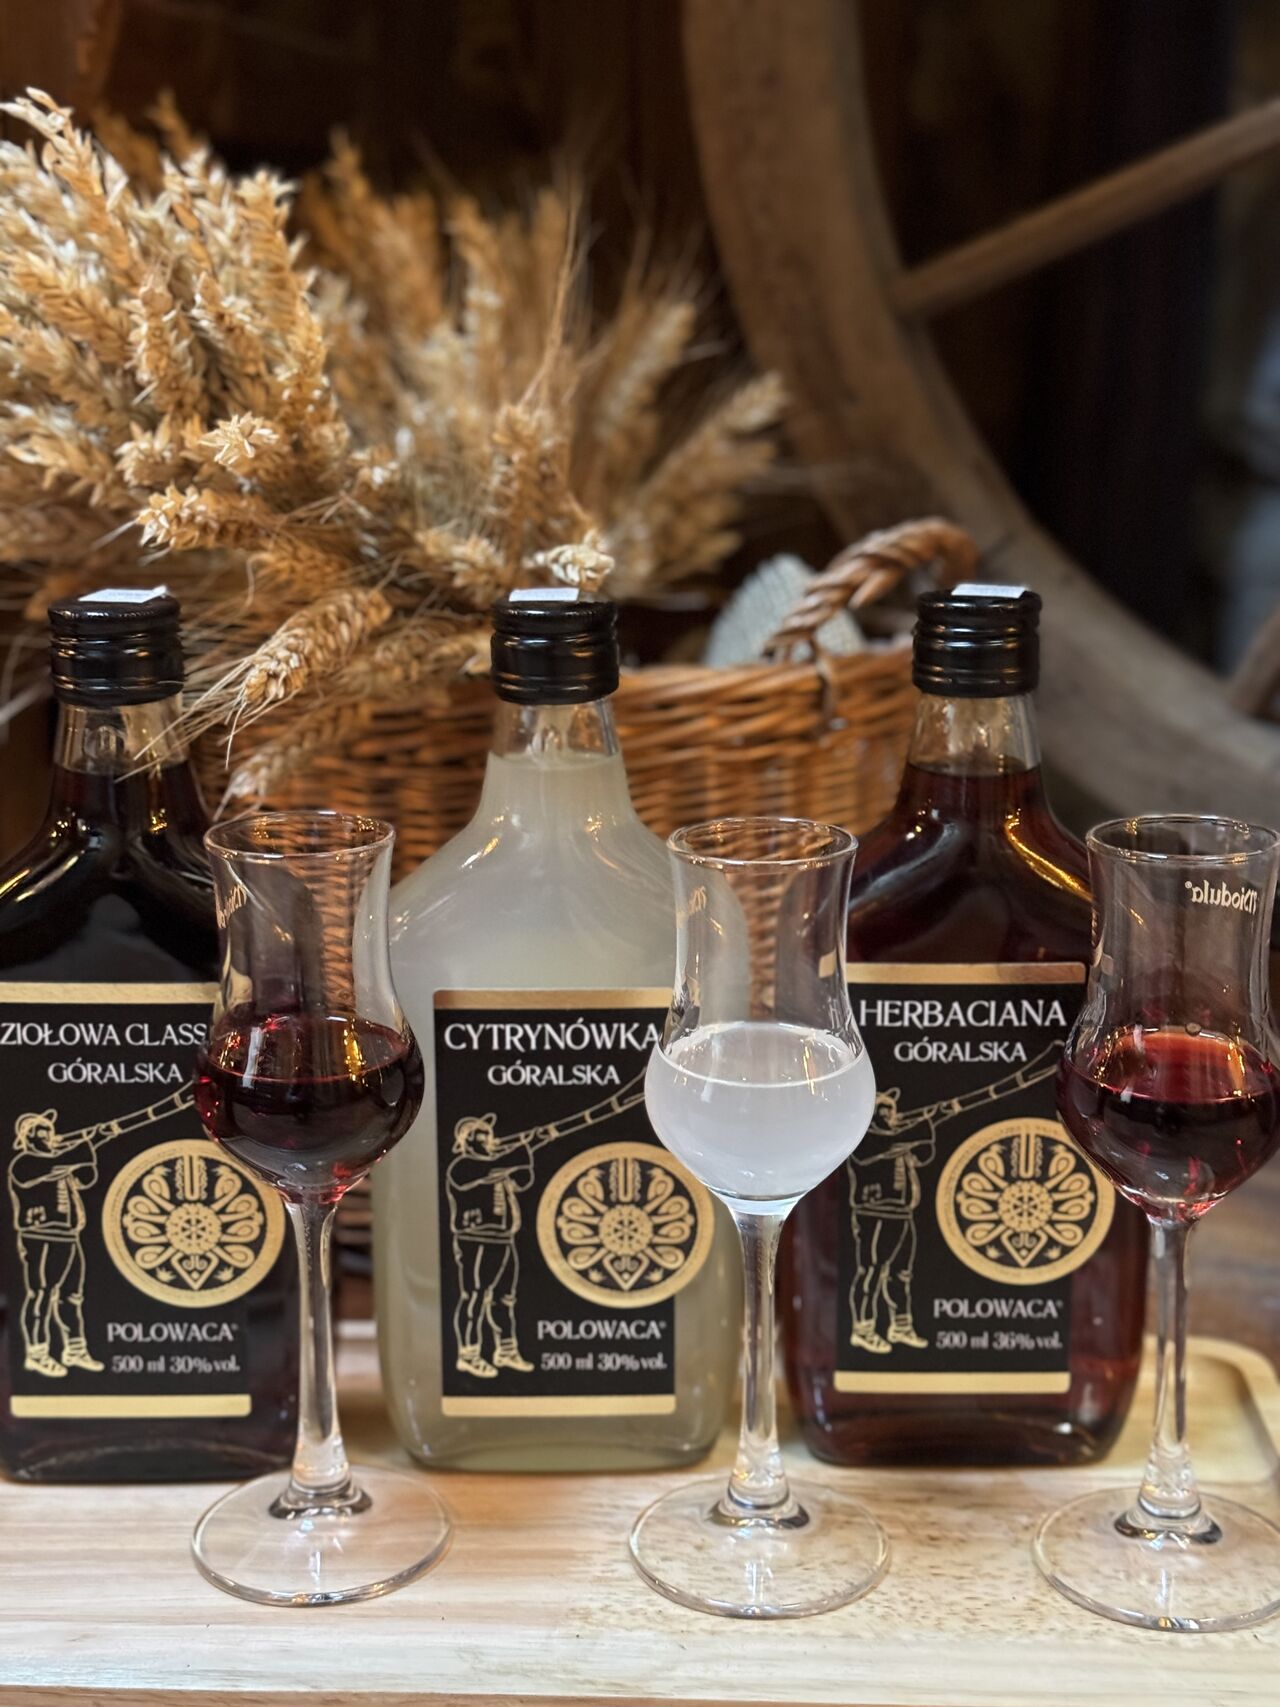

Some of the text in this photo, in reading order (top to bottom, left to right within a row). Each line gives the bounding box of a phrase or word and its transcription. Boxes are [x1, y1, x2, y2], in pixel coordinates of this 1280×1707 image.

[859, 999, 1067, 1029] HERBACIANA
[0, 1022, 121, 1046] ZIOŁOWA
[444, 1017, 660, 1052] CYTRYNÓWKA
[894, 1036, 1028, 1063] GÓRALSKA
[48, 1057, 184, 1084] GÓRALSKA
[487, 1060, 620, 1087] GÓRALSKA
[936, 1331, 967, 1349] 500
[970, 1331, 989, 1349] ml
[1036, 1331, 1063, 1349] vol.
[112, 1355, 240, 1373] 500 ml 30% vol.
[541, 1352, 668, 1371] 500 ml 30% vol.
